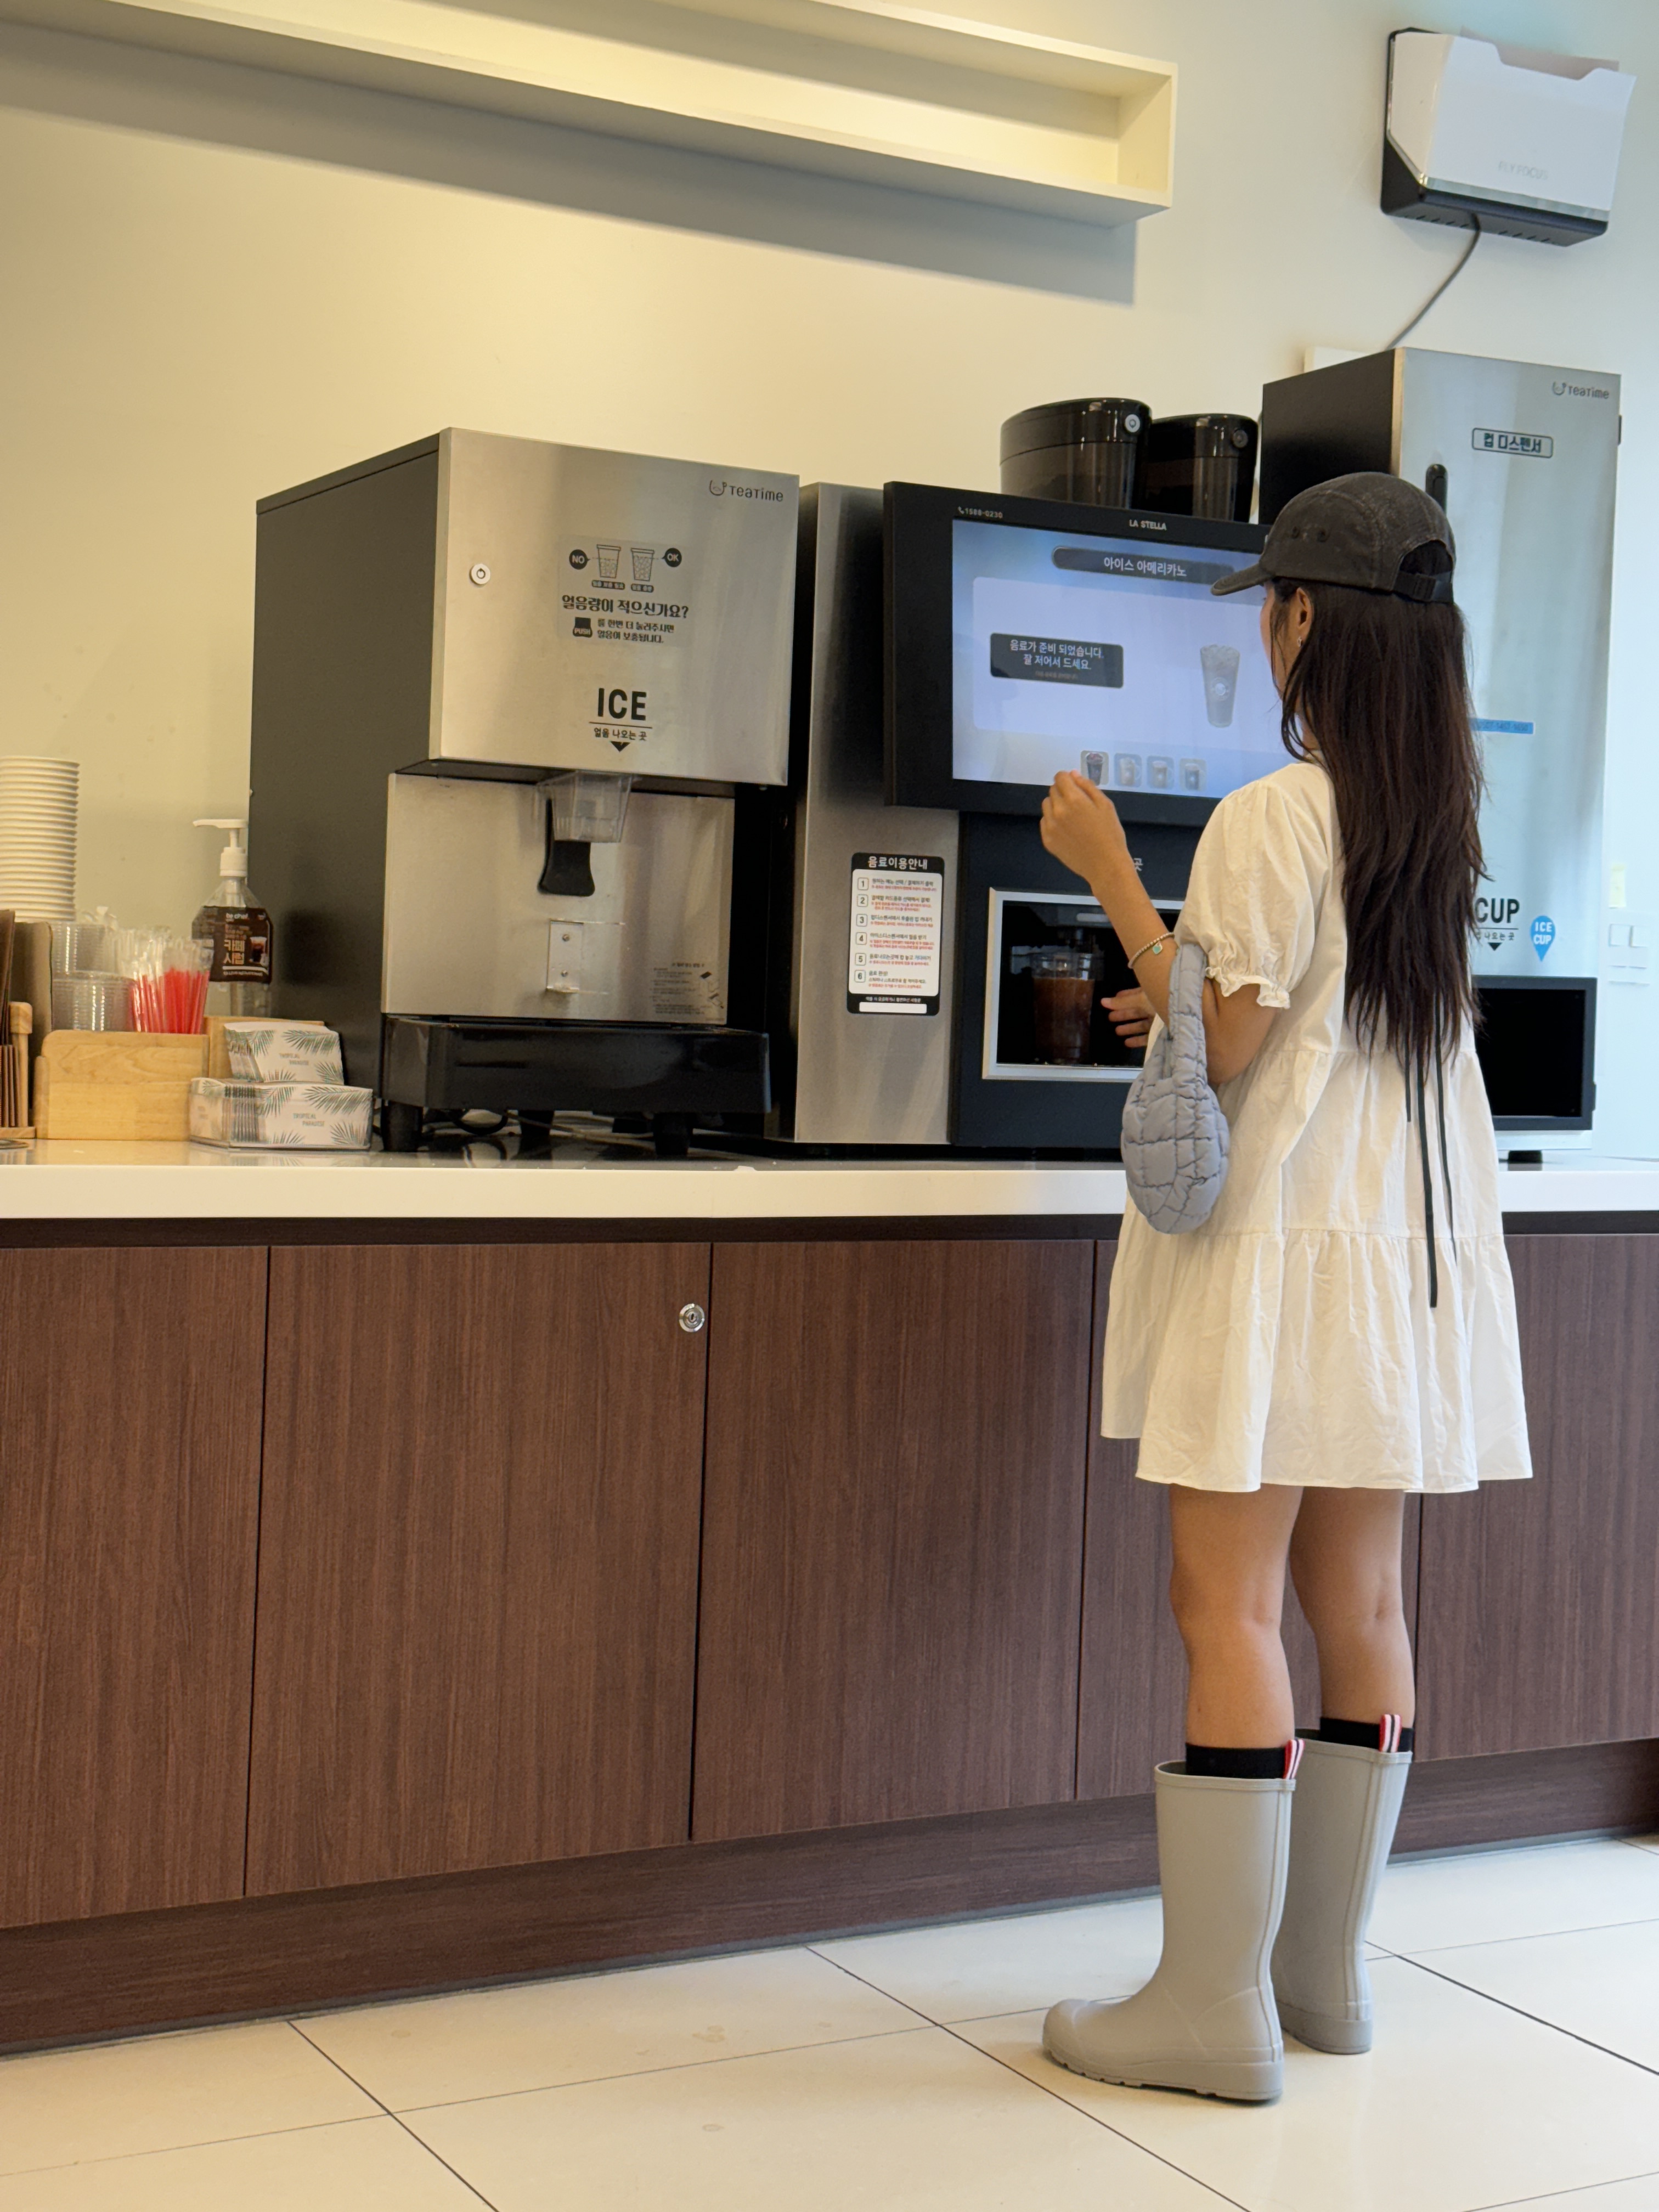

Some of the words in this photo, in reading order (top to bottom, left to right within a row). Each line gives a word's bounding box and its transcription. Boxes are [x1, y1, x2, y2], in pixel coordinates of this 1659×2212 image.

[1483, 432, 1494, 448] 컵
[1497, 434, 1542, 454] 디스펜서
[1129, 519, 1139, 528] LA
[1141, 520, 1167, 531] STELLA
[572, 555, 585, 564] NO
[667, 553, 679, 562] OK
[1103, 556, 1135, 572] 아이스
[1137, 559, 1188, 578] 아메리카노
[562, 595, 614, 613] 얼음량이
[617, 600, 689, 619] 적으신가요?
[1009, 639, 1037, 652] 음료가
[1039, 642, 1056, 654] 준비
[1058, 644, 1104, 658] 되었습니다.
[1023, 654, 1032, 665] 잘
[1034, 656, 1061, 668] 저어서
[1063, 658, 1092, 670] 드세요.
[597, 687, 647, 721] ICE
[594, 727, 609, 738] 얼음
[612, 729, 636, 740] 나오는
[638, 731, 647, 741] 곳
[867, 856, 928, 870] 음료이용안내
[1475, 897, 1520, 924] CUP
[1534, 921, 1553, 932] ICE
[1508, 932, 1515, 941] 곳
[1533, 934, 1552, 945] CUP
[223, 939, 245, 952] 카페
[223, 952, 245, 964] 시럽
